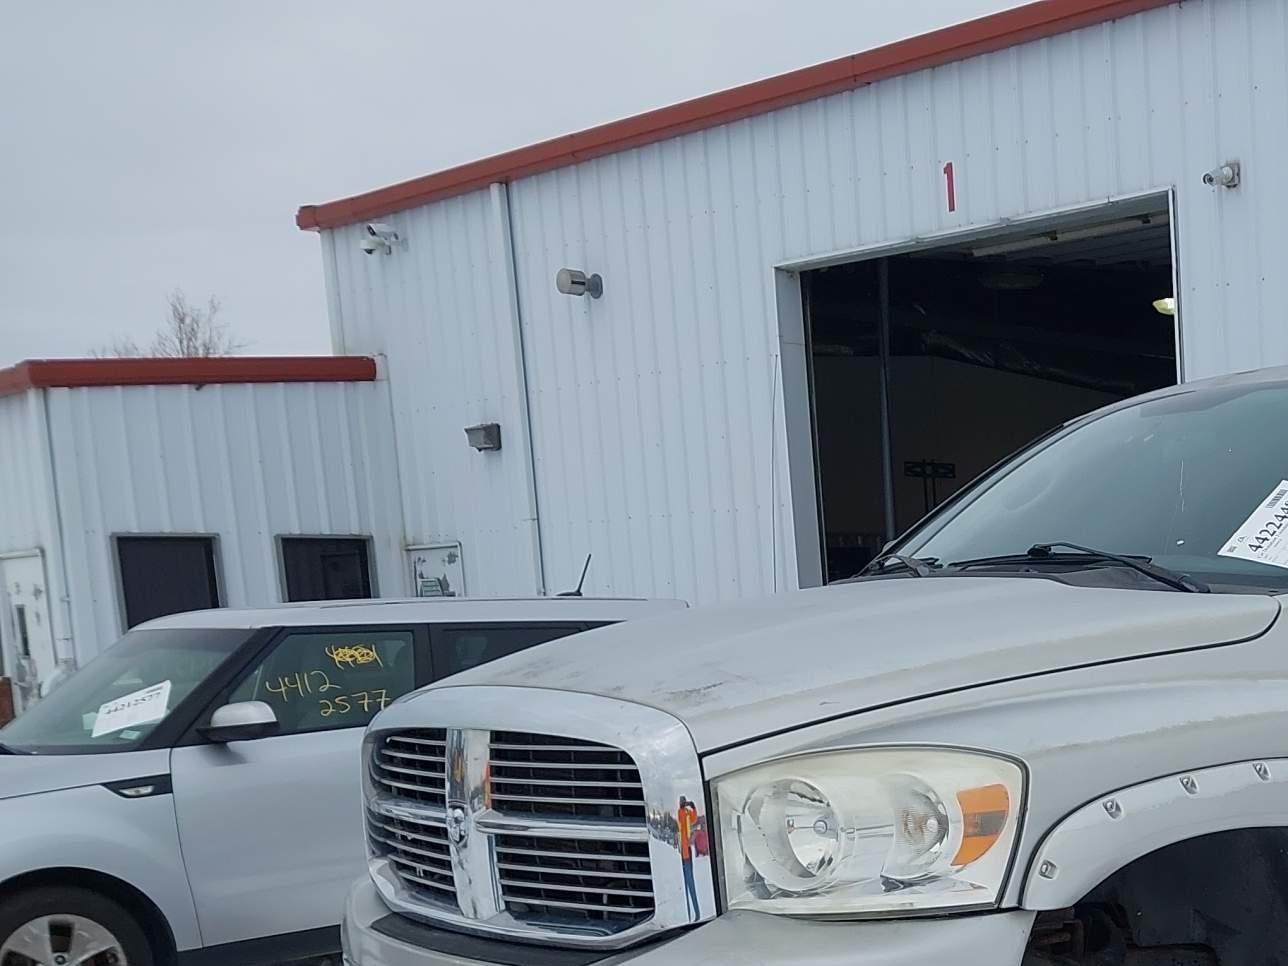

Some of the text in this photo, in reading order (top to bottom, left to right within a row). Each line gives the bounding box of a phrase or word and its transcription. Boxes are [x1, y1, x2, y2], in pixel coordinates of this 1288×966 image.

[943, 162, 956, 212] 1
[265, 670, 342, 702] 4412
[319, 689, 391, 717] 2577
